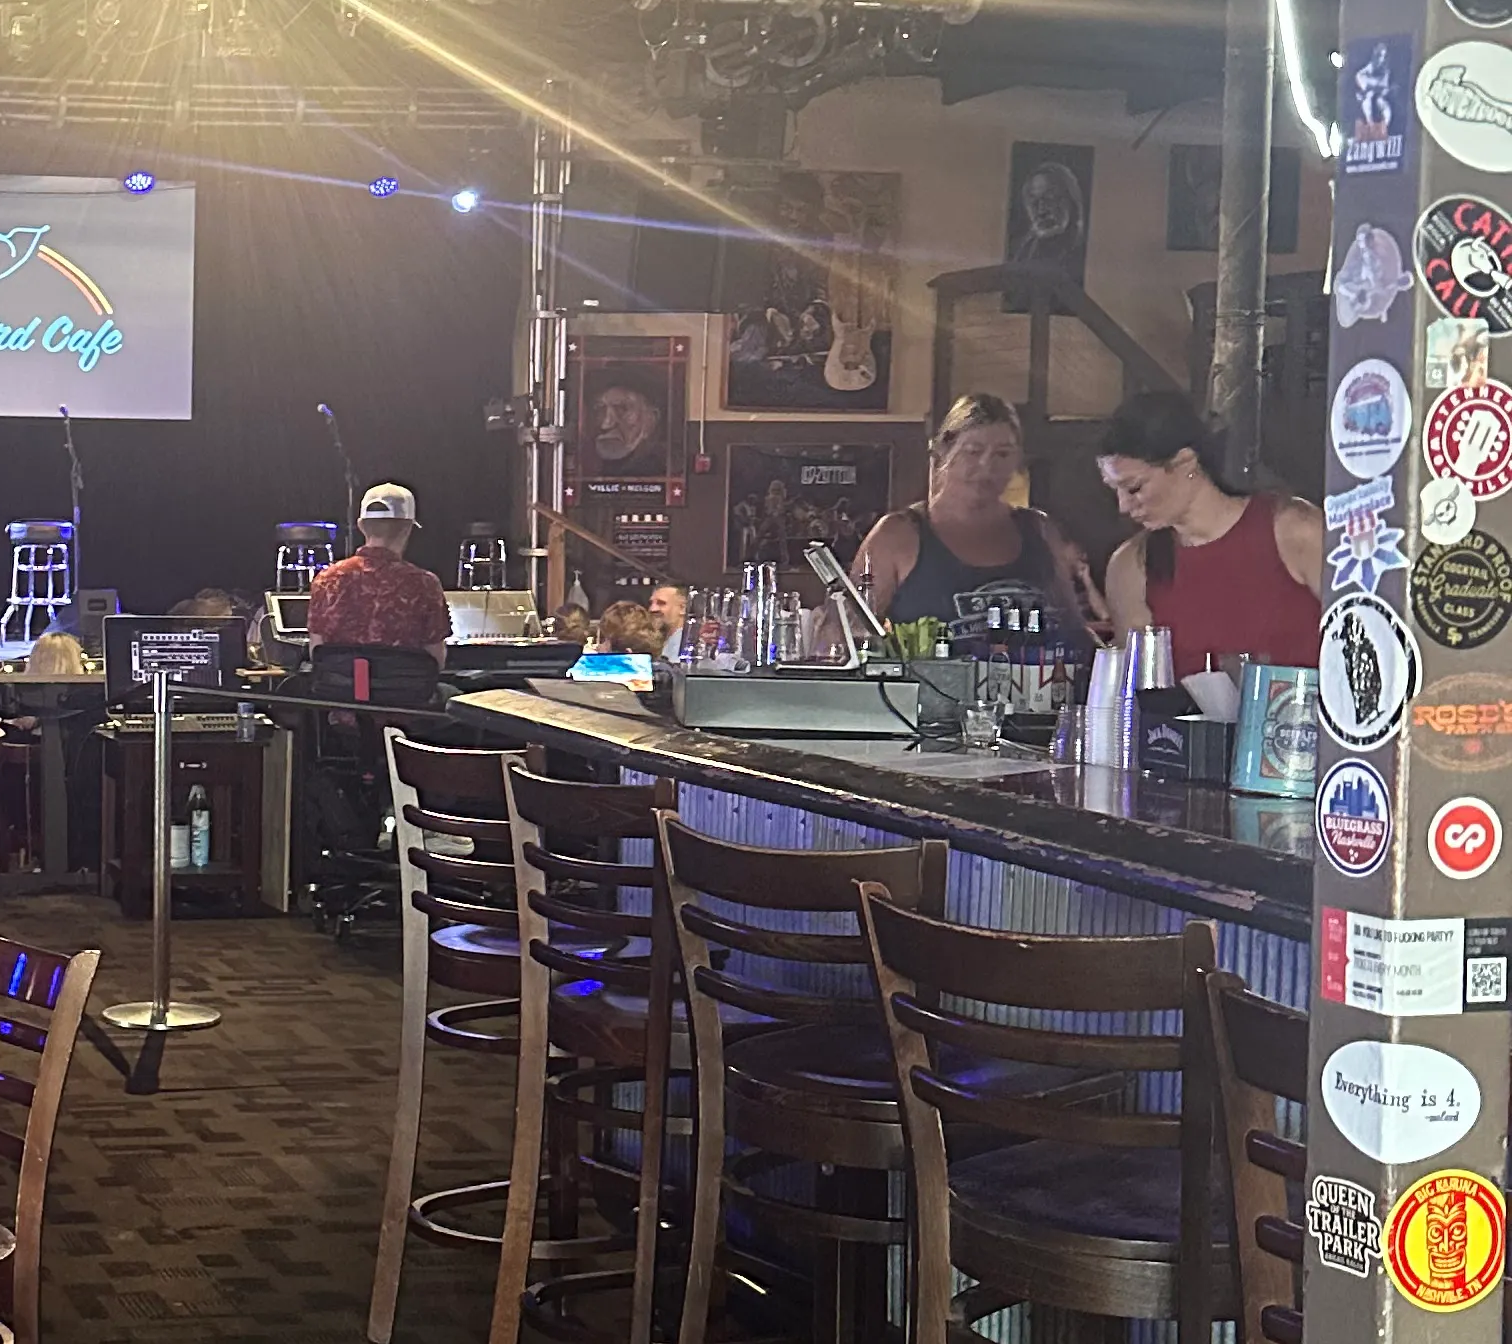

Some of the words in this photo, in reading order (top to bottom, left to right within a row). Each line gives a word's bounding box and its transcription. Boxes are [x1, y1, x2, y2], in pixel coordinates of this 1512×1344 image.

[42, 315, 123, 373] Cafe
[588, 483, 620, 492] WILLIE
[627, 484, 662, 493] NELSON
[1325, 816, 1383, 837] BLUEGRASS
[1334, 1070, 1413, 1113] Everything
[1420, 1088, 1437, 1107] is
[1445, 1088, 1461, 1107] 4.
[1317, 1181, 1369, 1217] QUEEN
[1414, 1182, 1436, 1204] BIG
[1310, 1207, 1380, 1251] TRAILER
[1324, 1233, 1364, 1262] PARK
